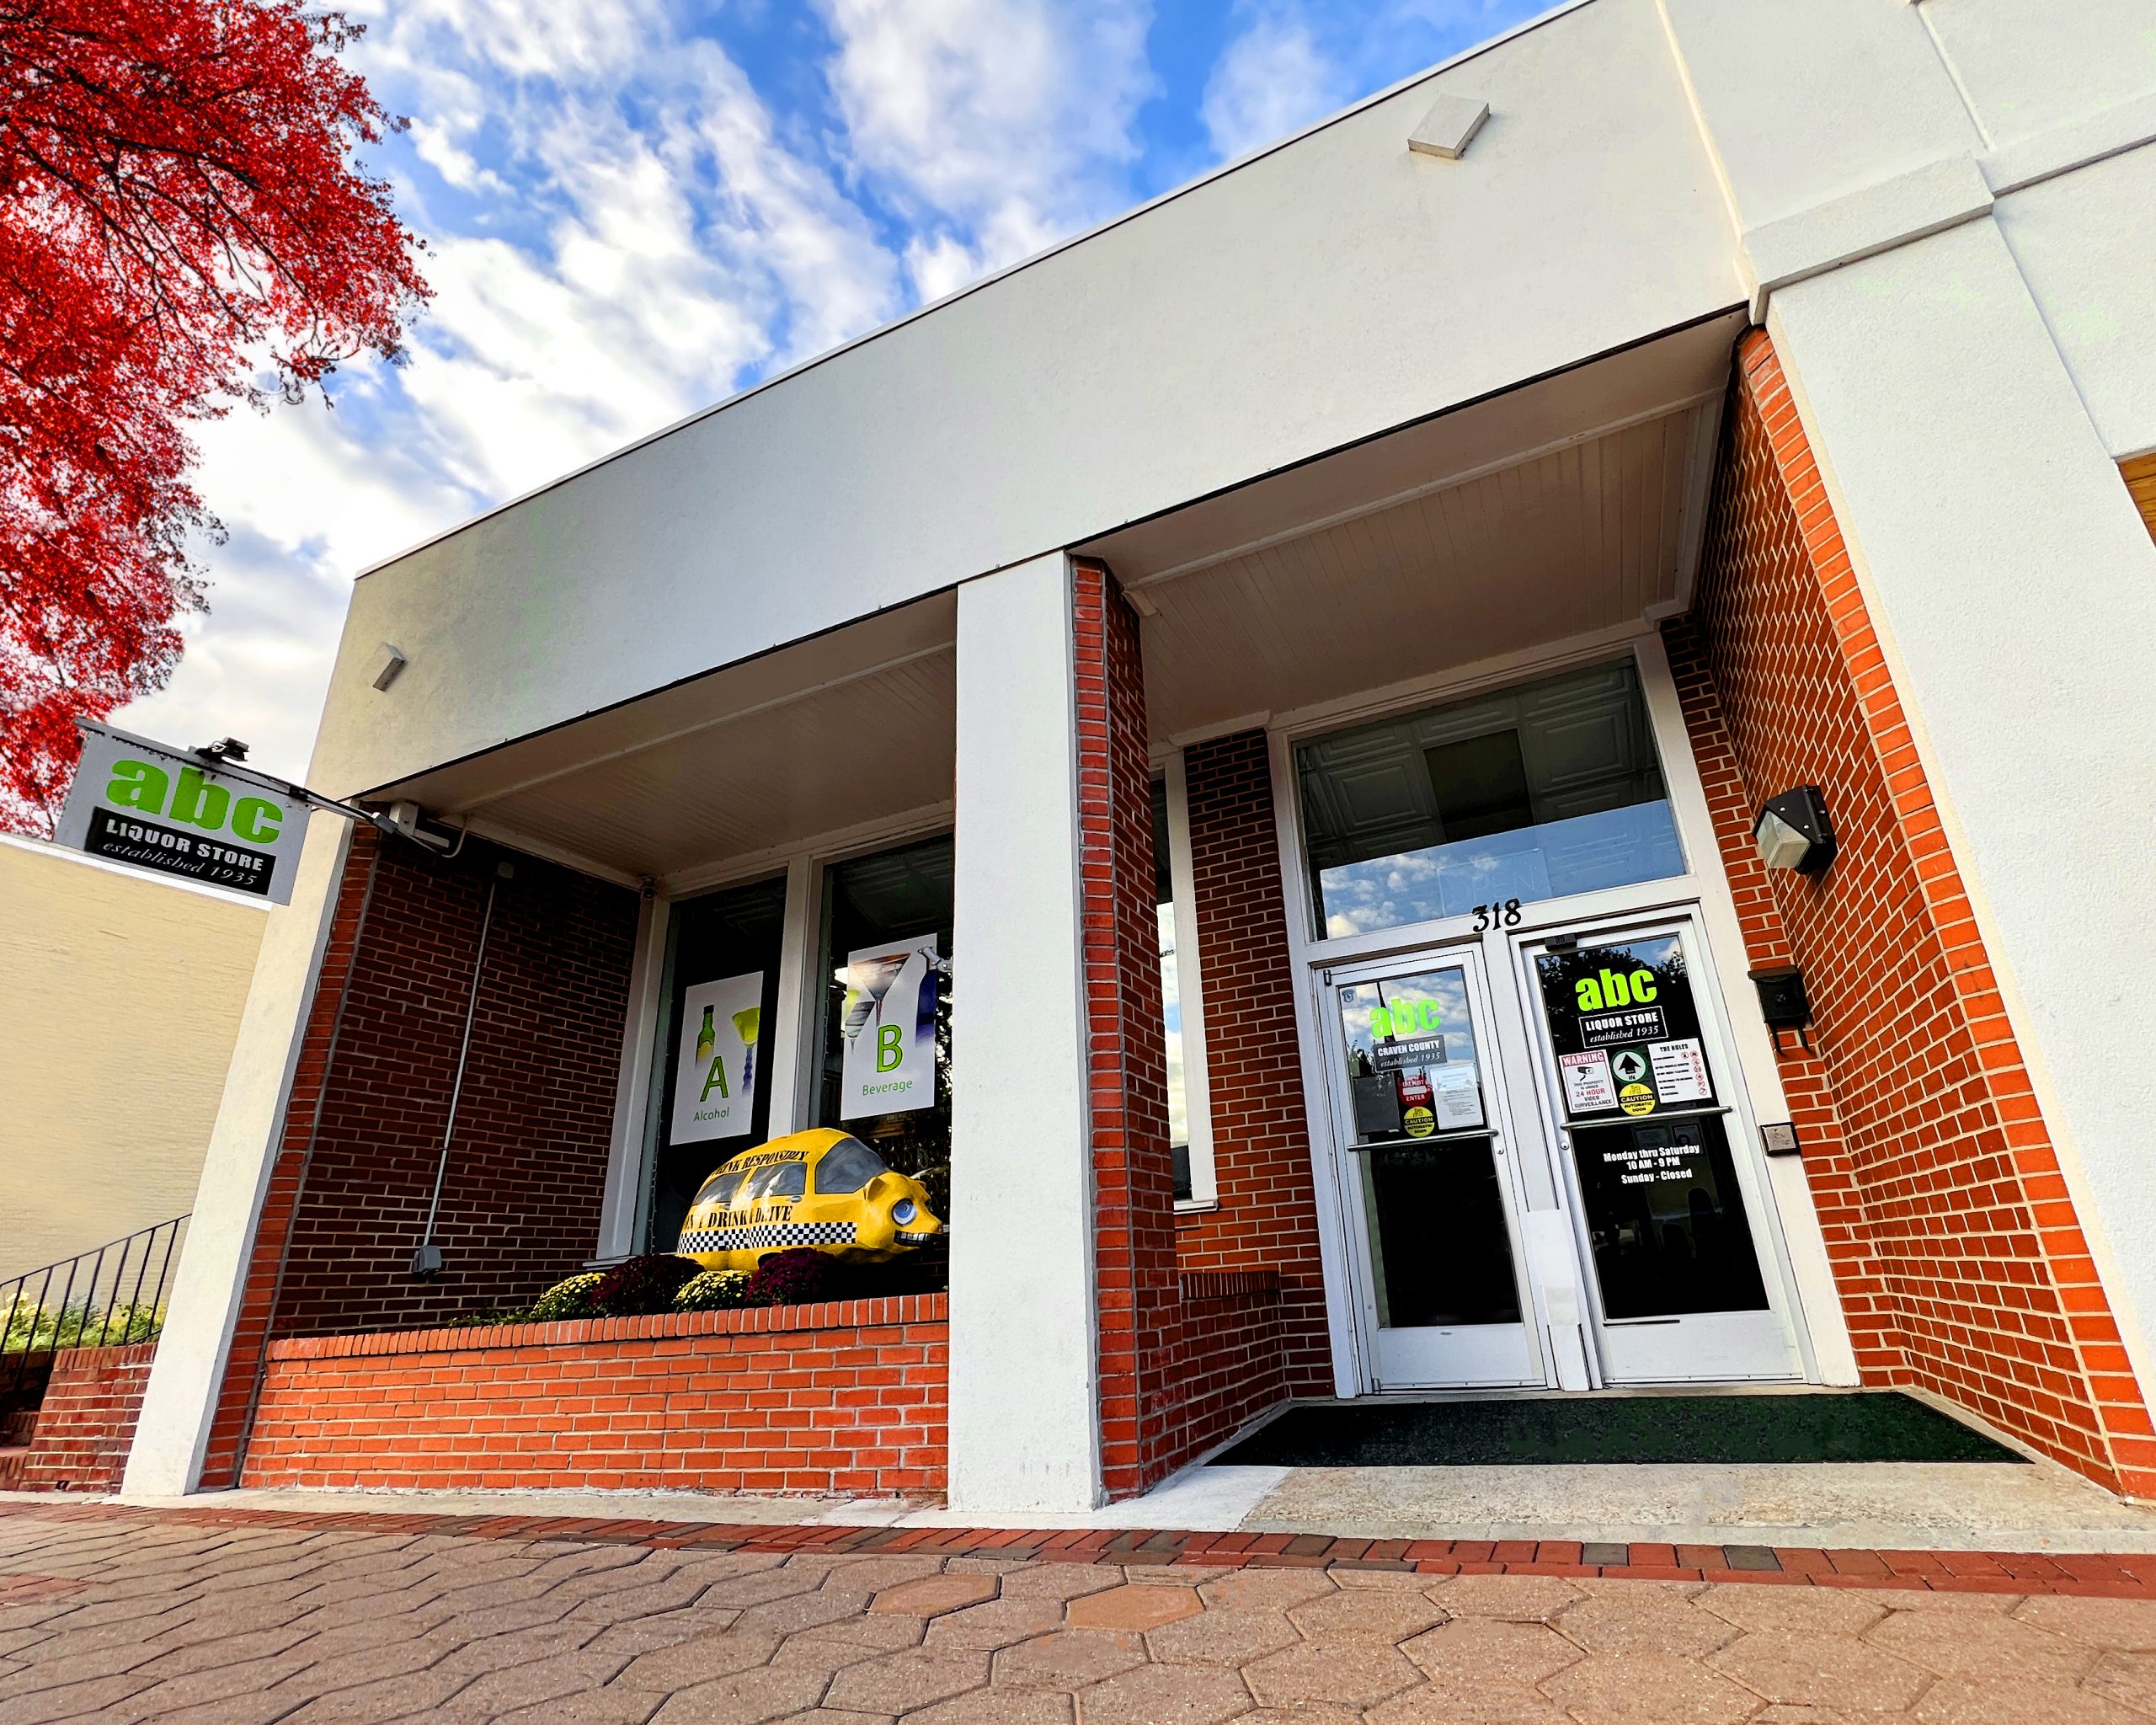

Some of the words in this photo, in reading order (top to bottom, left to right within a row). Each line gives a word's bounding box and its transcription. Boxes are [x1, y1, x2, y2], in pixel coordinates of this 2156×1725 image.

[106, 760, 282, 844] abc
[106, 818, 190, 852] LIQUOR
[196, 843, 264, 871] STORE
[102, 841, 205, 874] established
[210, 865, 258, 886] 1935
[1471, 898, 1521, 932] 318
[1575, 969, 1657, 1011] abc
[1369, 998, 1440, 1038] abc
[1585, 1017, 1623, 1031] LIQUOR
[1625, 1012, 1659, 1025] STORE
[1590, 1028, 1633, 1043] established
[1636, 1025, 1658, 1036] 1935
[876, 1024, 904, 1073] B
[1378, 1044, 1407, 1056] CRAVEN
[1408, 1040, 1439, 1052] COUNTY
[1380, 1053, 1418, 1067] established
[1421, 1052, 1440, 1061] 1935
[1563, 1052, 1604, 1065] WARNING
[700, 1056, 728, 1103] A
[862, 1079, 913, 1096] Beverage
[1620, 1094, 1653, 1103] CAUTION
[693, 1107, 729, 1122] Alcohol
[1603, 1151, 1638, 1162] Monday
[1639, 1149, 1658, 1158] thru
[1659, 1145, 1700, 1156] Saturday
[1626, 1161, 1637, 1170] 10
[1638, 1159, 1652, 1169] AM
[1657, 1158, 1665, 1167] 9
[1666, 1156, 1681, 1167] PM
[1621, 1172, 1654, 1183] Sunday
[1660, 1168, 1693, 1180] Closed
[707, 1210, 748, 1228] DRINK
[755, 1206, 792, 1223] DRIVE
